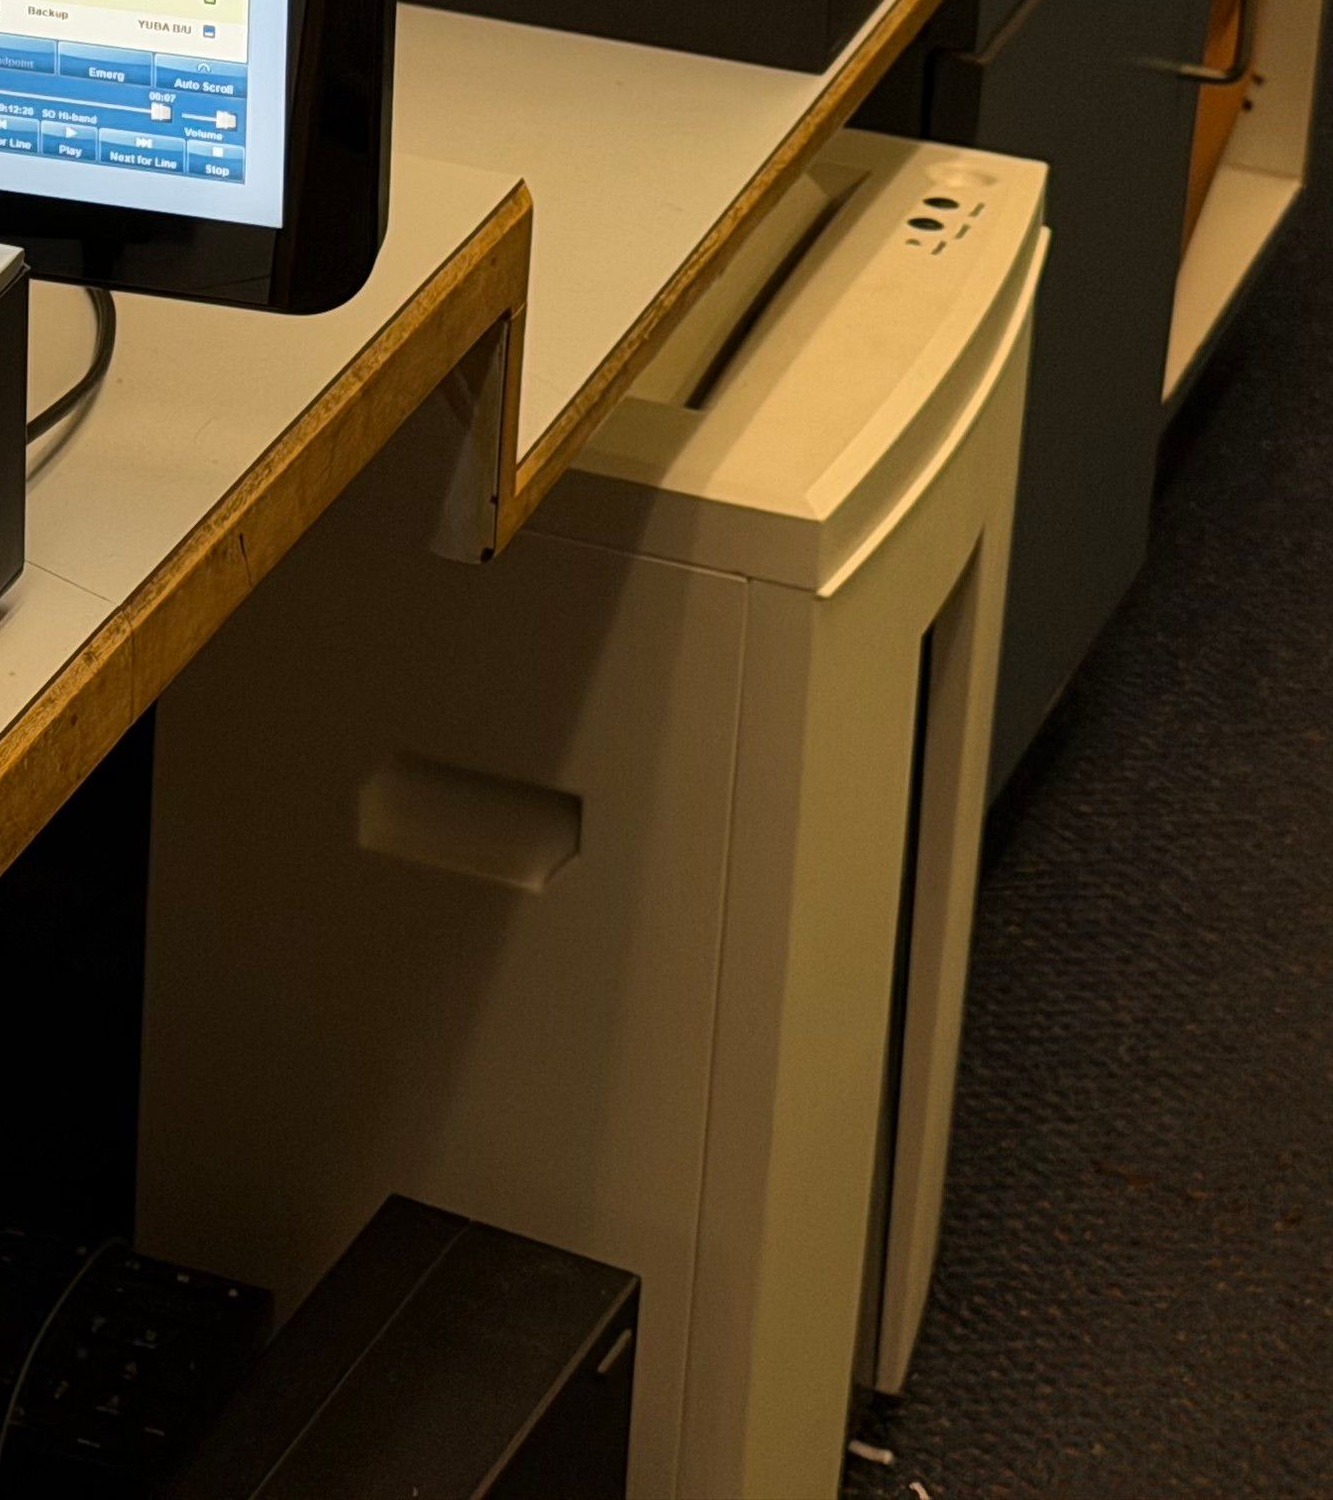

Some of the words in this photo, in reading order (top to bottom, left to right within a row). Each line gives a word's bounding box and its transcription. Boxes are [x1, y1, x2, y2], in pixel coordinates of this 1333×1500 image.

[88, 67, 125, 82] Emerg
[174, 77, 200, 91] Auto
[201, 80, 234, 95] Scroll
[184, 127, 223, 142] Volume
[9, 137, 32, 151] Line
[58, 144, 82, 159] Play
[109, 151, 135, 164] Next
[136, 153, 153, 166] for
[154, 156, 177, 170] Line
[204, 163, 230, 178] Stop
